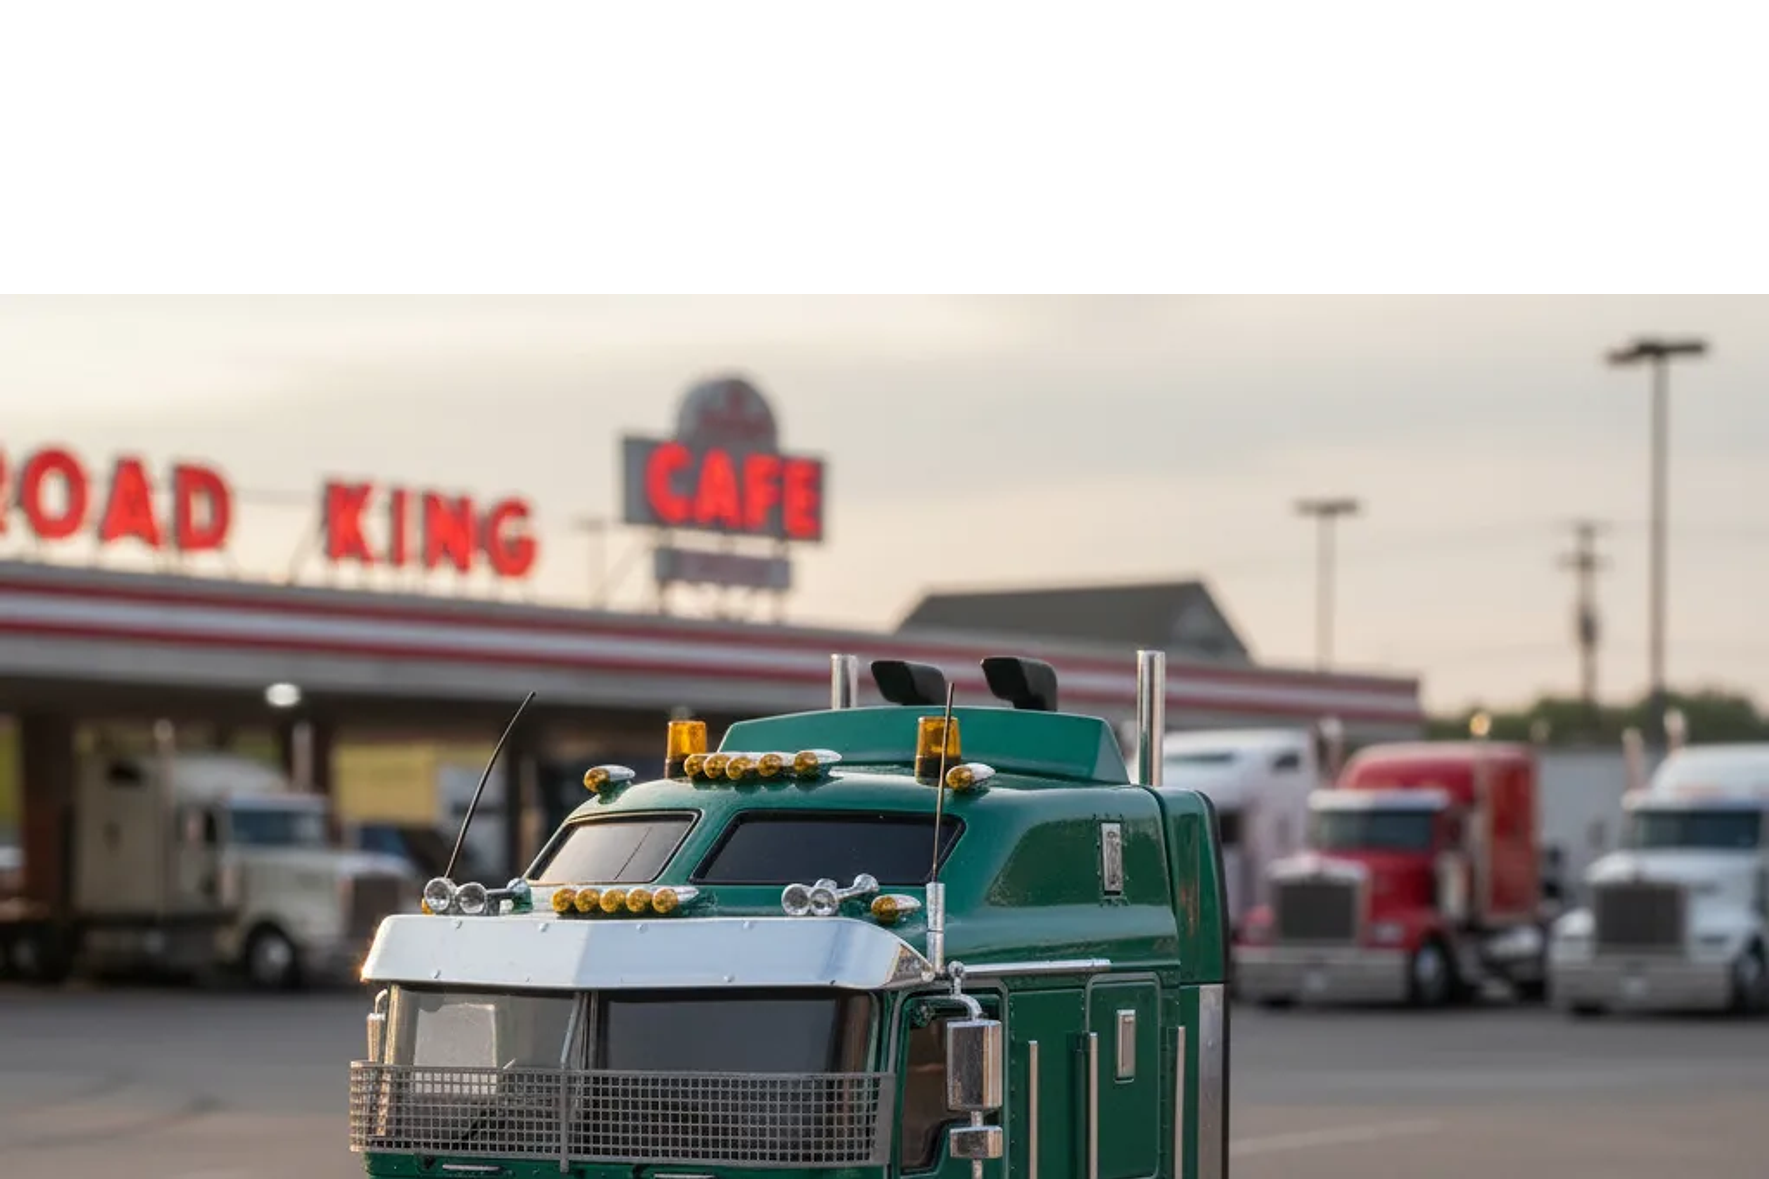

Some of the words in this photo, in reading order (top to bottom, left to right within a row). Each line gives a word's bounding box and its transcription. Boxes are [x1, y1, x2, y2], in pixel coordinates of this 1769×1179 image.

[0, 447, 232, 552] OAD
[325, 482, 539, 580] KING
[644, 441, 822, 540] CAFE
